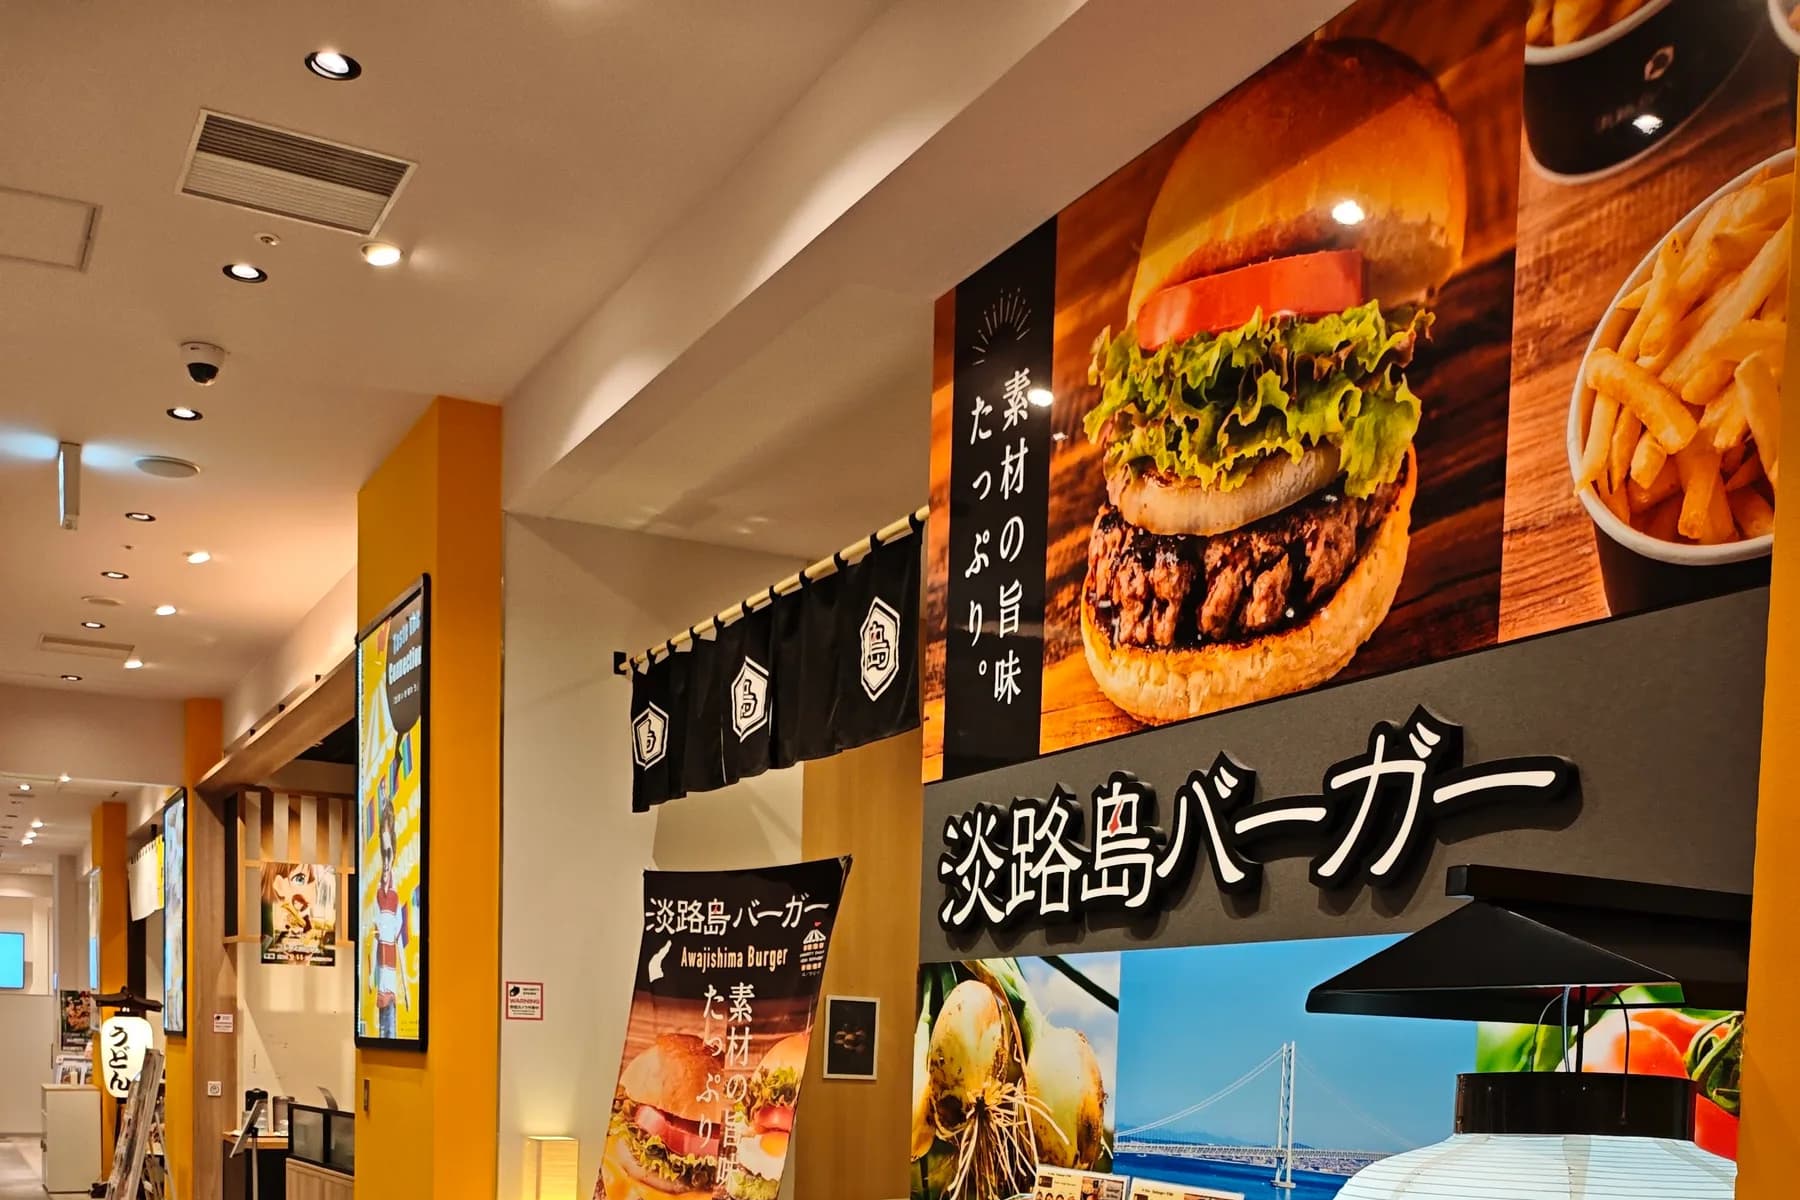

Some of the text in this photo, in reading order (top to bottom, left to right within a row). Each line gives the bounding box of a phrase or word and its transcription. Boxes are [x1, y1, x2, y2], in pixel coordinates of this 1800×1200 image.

[993, 367, 1030, 705] 素材の旨味
[940, 718, 1560, 926] 淡路島バーガー
[645, 891, 830, 936] 淡路島バーガー
[681, 946, 743, 974] Awajishima
[747, 945, 789, 973] Burger
[109, 1025, 131, 1092] うどん
[716, 982, 755, 1187] 素材の旨味
